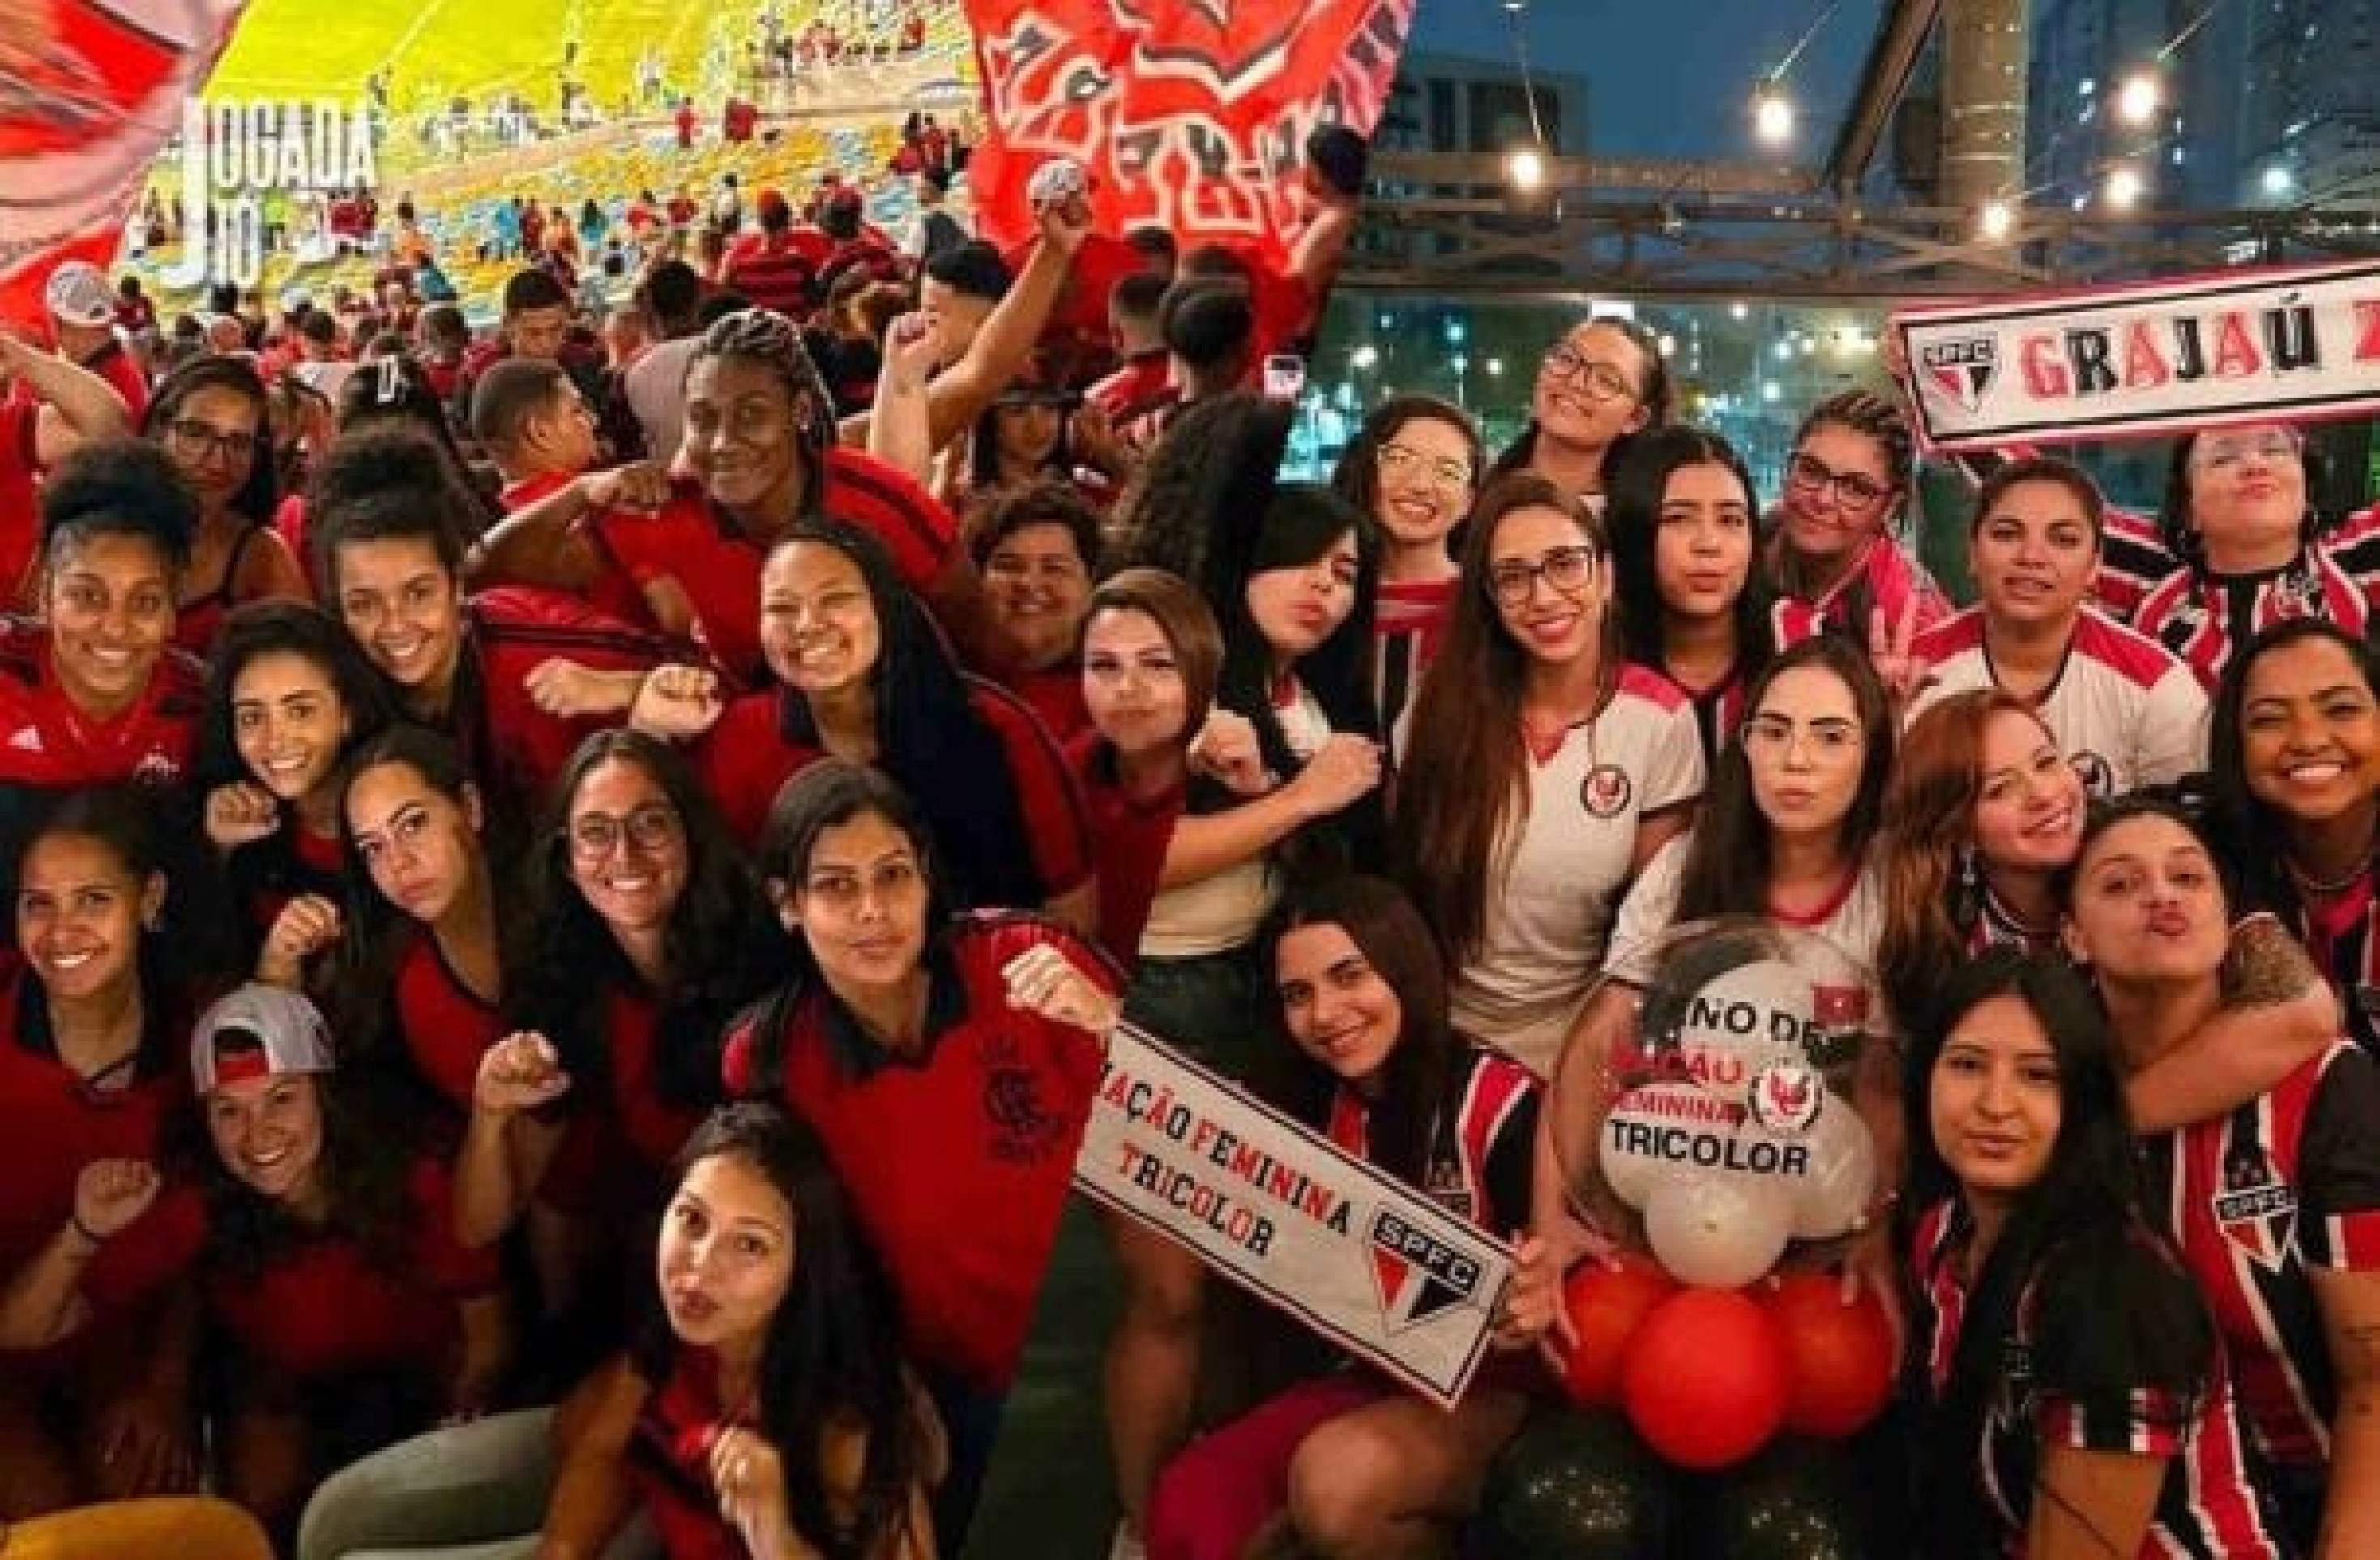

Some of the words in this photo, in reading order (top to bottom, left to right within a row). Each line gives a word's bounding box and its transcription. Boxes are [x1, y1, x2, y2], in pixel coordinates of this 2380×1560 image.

[2020, 290, 2321, 400] GRAJAÚ
[1117, 1141, 1276, 1258] TRICOLOR
[1190, 1117, 1352, 1236] FEMININA
[1609, 1118, 1813, 1177] TRICOLOR
[1379, 1217, 1476, 1286] SPFC
